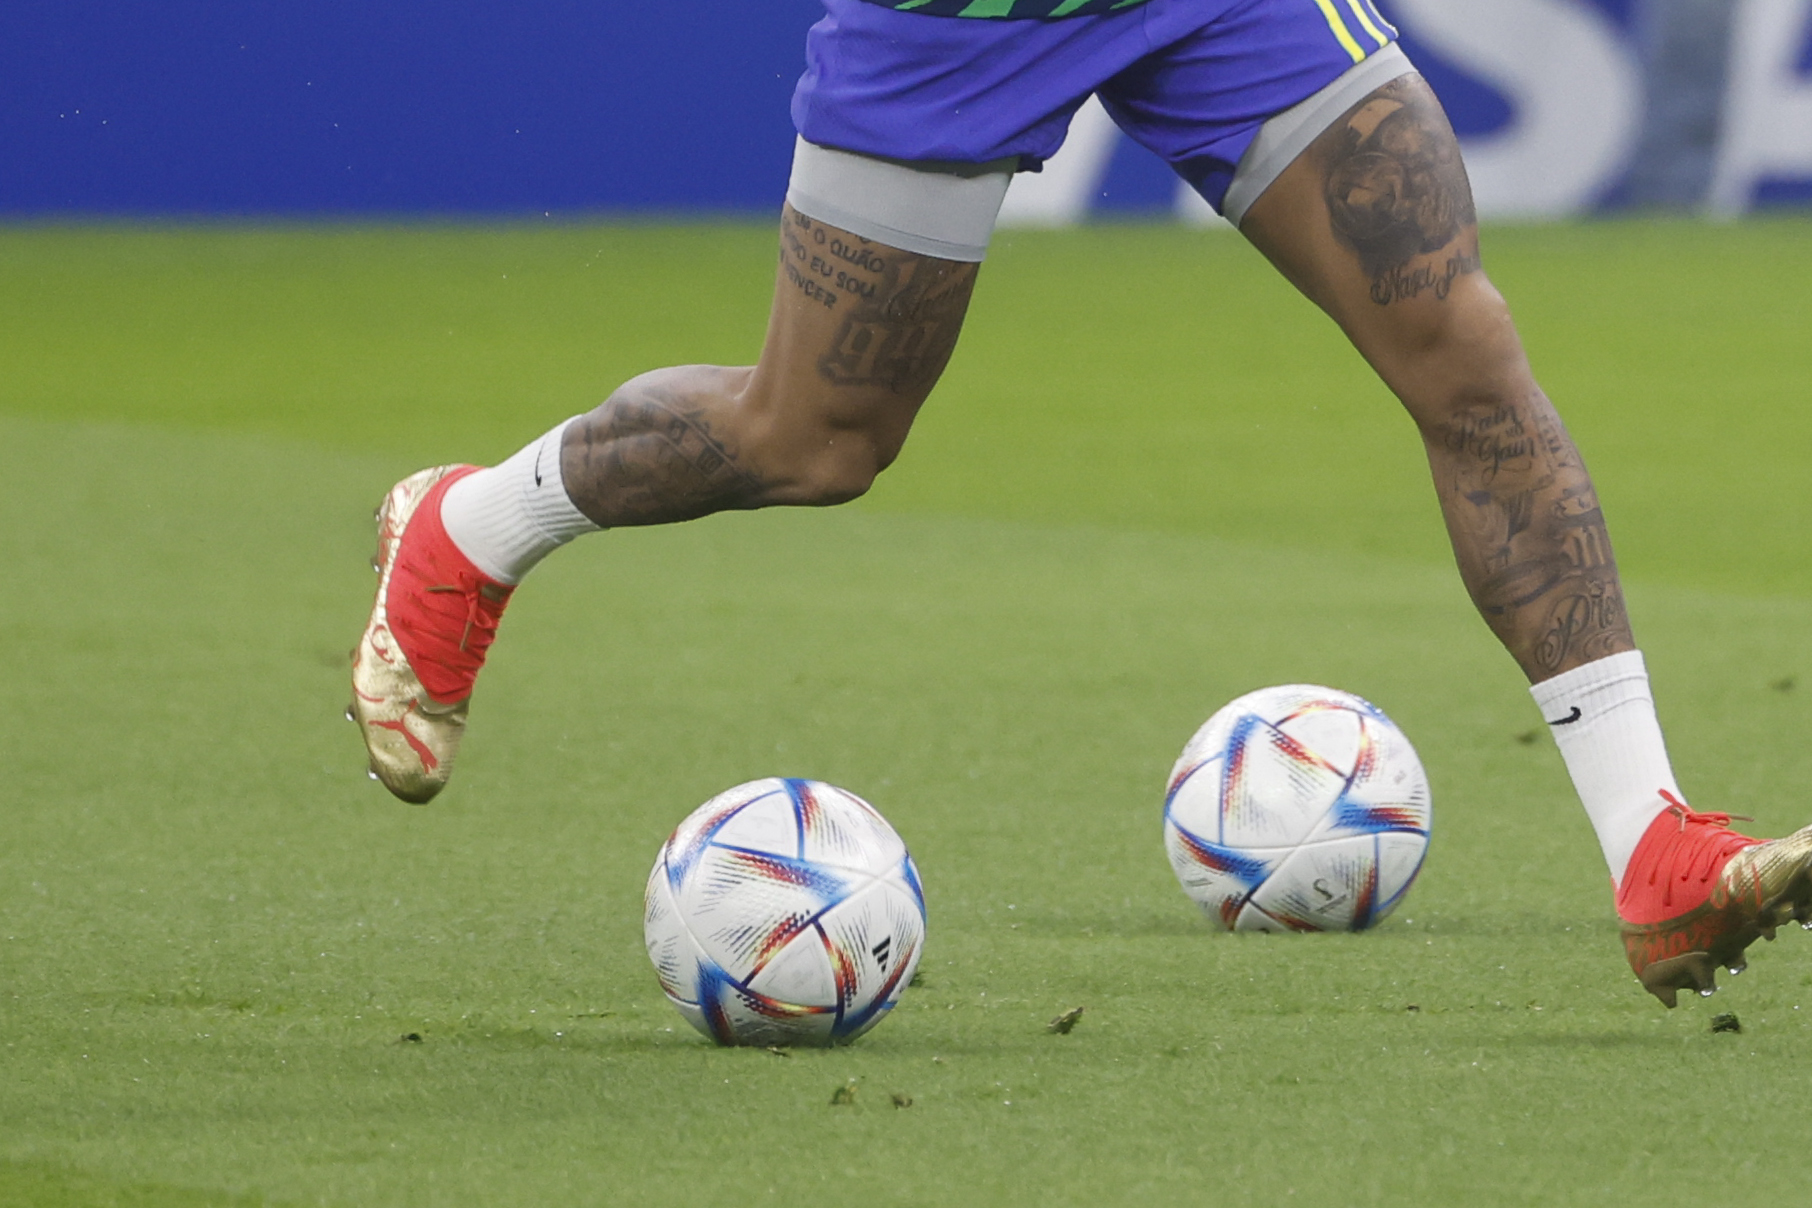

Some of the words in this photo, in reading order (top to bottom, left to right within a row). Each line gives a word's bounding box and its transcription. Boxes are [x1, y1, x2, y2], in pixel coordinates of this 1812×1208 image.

[830, 238, 885, 273] QUÃO
[810, 256, 833, 277] EU
[836, 271, 876, 298] SOU
